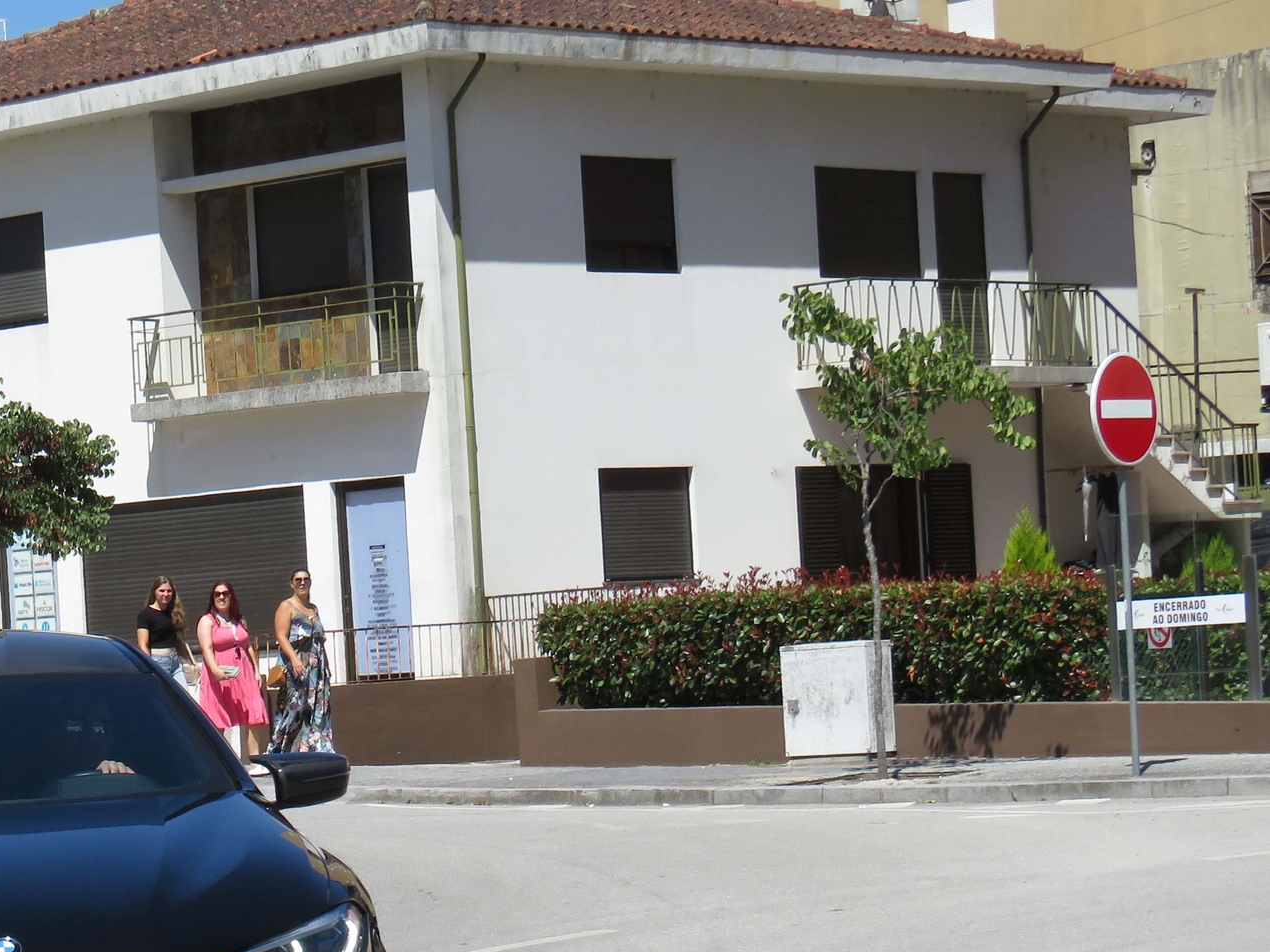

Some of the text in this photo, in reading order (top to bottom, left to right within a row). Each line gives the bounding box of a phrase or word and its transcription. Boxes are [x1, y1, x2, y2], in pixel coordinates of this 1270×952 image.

[1153, 599, 1207, 613] ENCERRADO
[1152, 611, 1208, 625] AO DOMINGO
